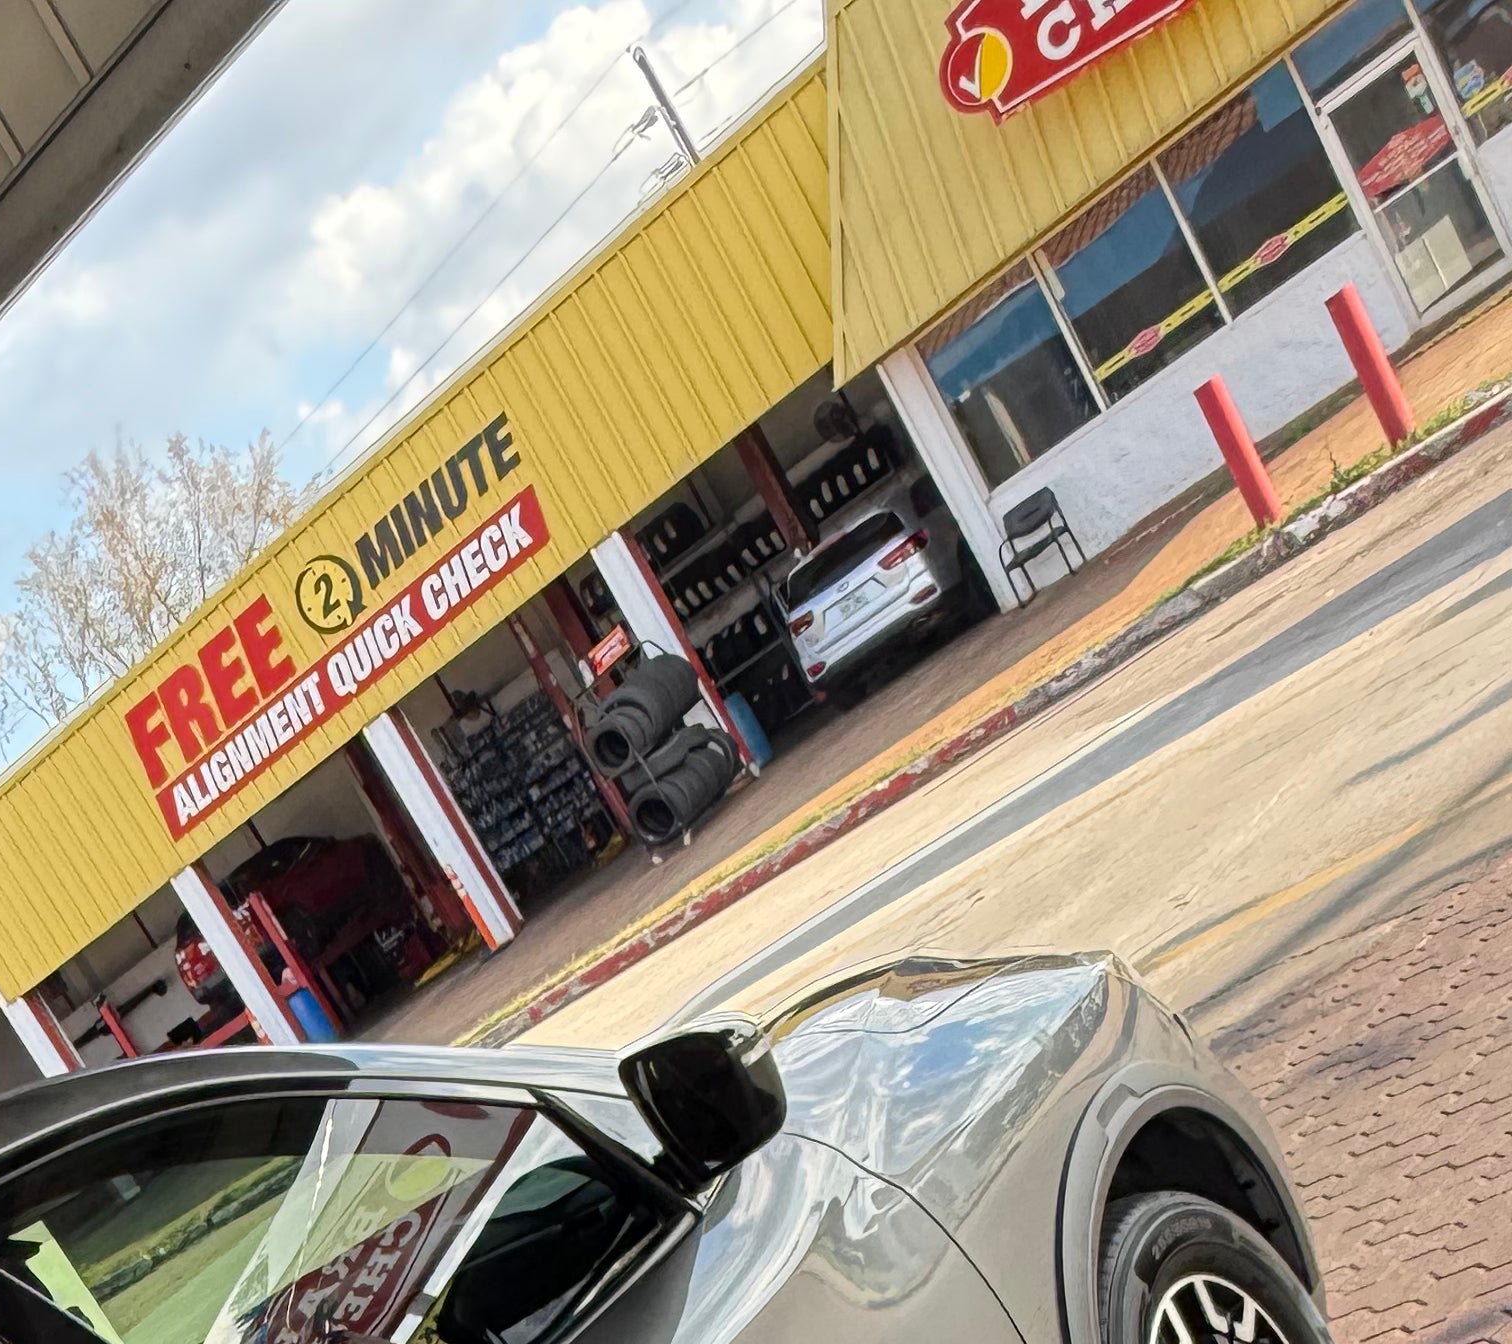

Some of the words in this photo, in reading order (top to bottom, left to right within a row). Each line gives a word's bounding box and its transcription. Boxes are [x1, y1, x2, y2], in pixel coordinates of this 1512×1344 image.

[125, 594, 297, 790] FREE
[314, 572, 342, 619] 2
[355, 411, 521, 590] MINUTE
[172, 675, 326, 827] ALIGNMENT
[326, 594, 424, 697] QUICK
[420, 502, 534, 621] CHECK
